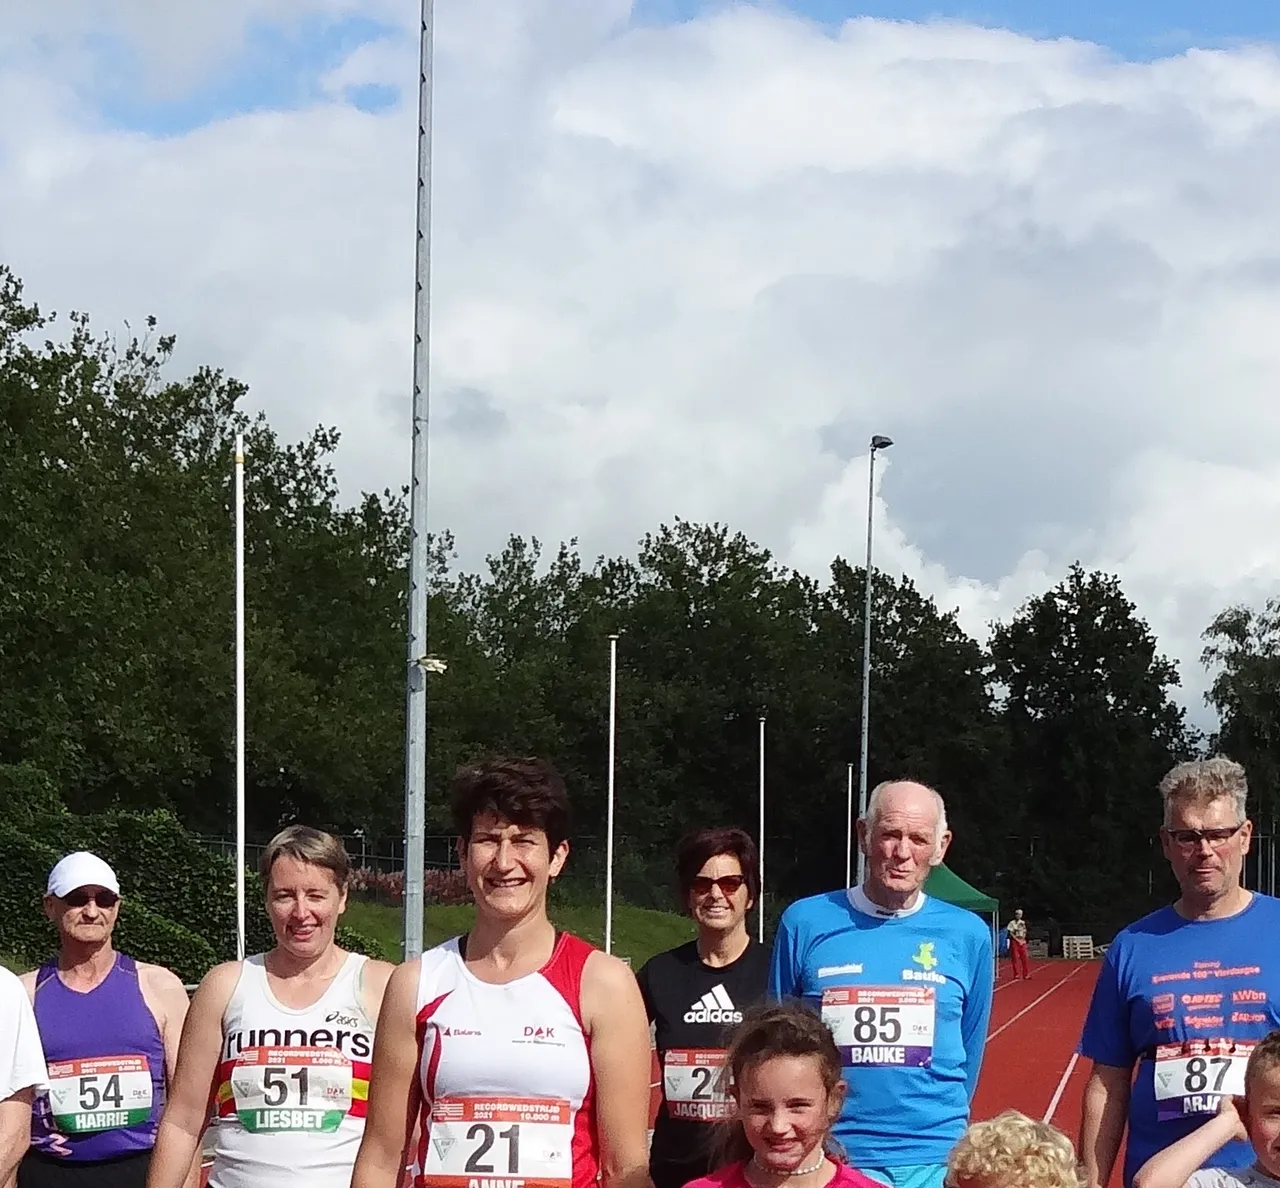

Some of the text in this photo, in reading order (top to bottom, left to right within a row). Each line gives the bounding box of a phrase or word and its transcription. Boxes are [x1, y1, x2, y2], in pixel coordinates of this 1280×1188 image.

[902, 969, 947, 984] Bauke
[336, 1014, 359, 1028] asics
[684, 1008, 743, 1023] adidas
[853, 1006, 902, 1043] 85
[228, 1028, 370, 1058] runners
[851, 1047, 905, 1064] BAUKE
[1184, 1056, 1233, 1093] 87
[79, 1074, 124, 1110] 54
[263, 1067, 309, 1107] 51
[474, 1103, 561, 1114] RECORDWEDSTRIJD
[474, 1111, 493, 1119] 2021
[75, 1111, 129, 1129] HARRIE
[256, 1110, 326, 1129] LIESBET
[464, 1123, 520, 1174] 21
